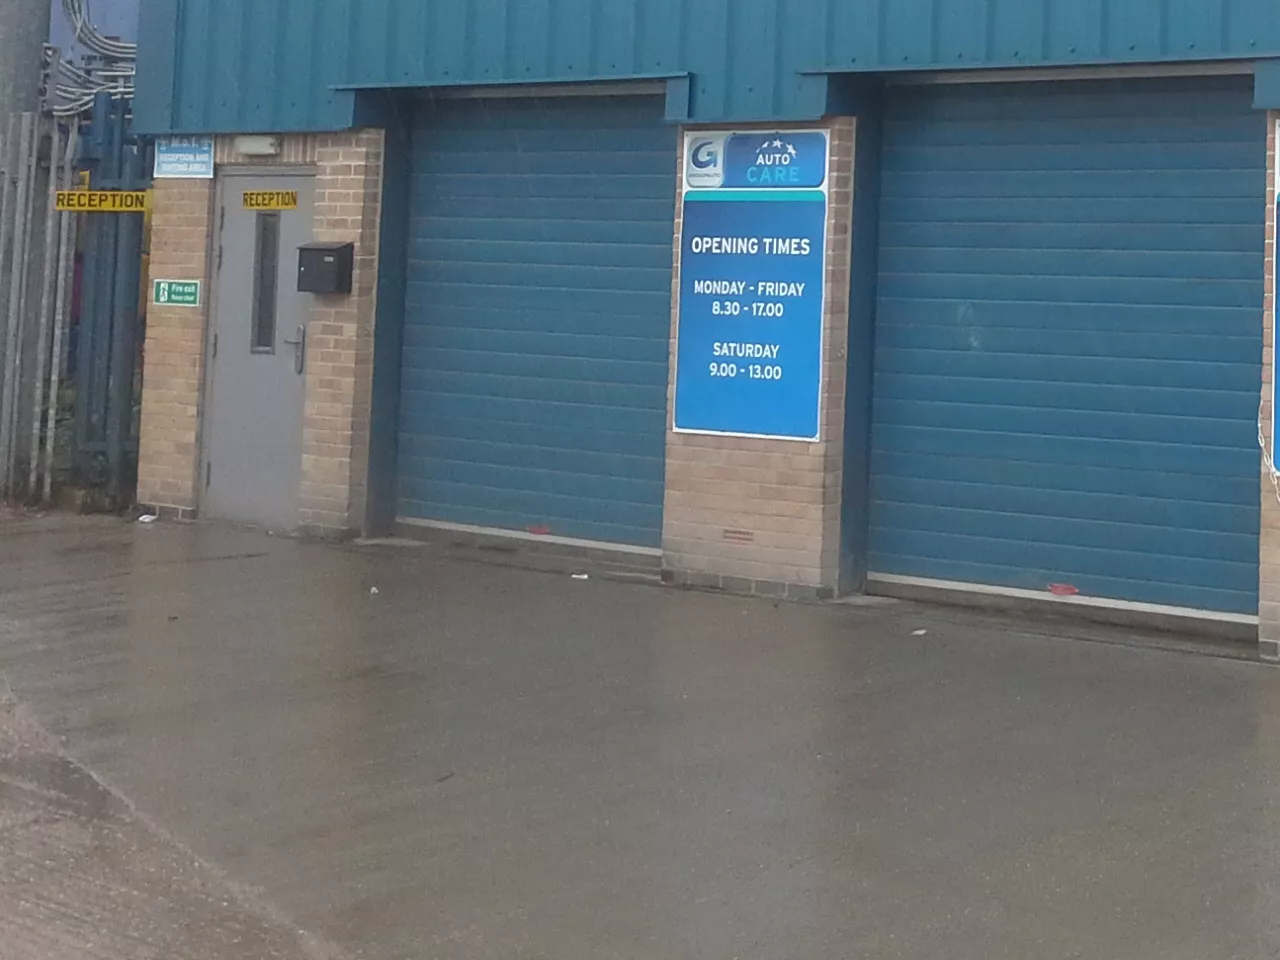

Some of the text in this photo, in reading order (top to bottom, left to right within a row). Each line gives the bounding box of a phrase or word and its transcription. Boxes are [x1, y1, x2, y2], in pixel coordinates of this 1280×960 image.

[756, 154, 790, 165] AUTO
[746, 166, 800, 182] CARE
[56, 192, 145, 208] RECEPTION
[243, 191, 297, 207] RECEPTION
[692, 237, 810, 255] OPENING TIMES
[694, 280, 745, 296] MONDAY
[758, 282, 805, 297] FRIDAY
[712, 302, 740, 315] 8.30
[752, 302, 784, 317] 17.00
[713, 342, 779, 359] SATURDAY
[709, 363, 736, 377] 9.00
[749, 365, 782, 380] 13.00
